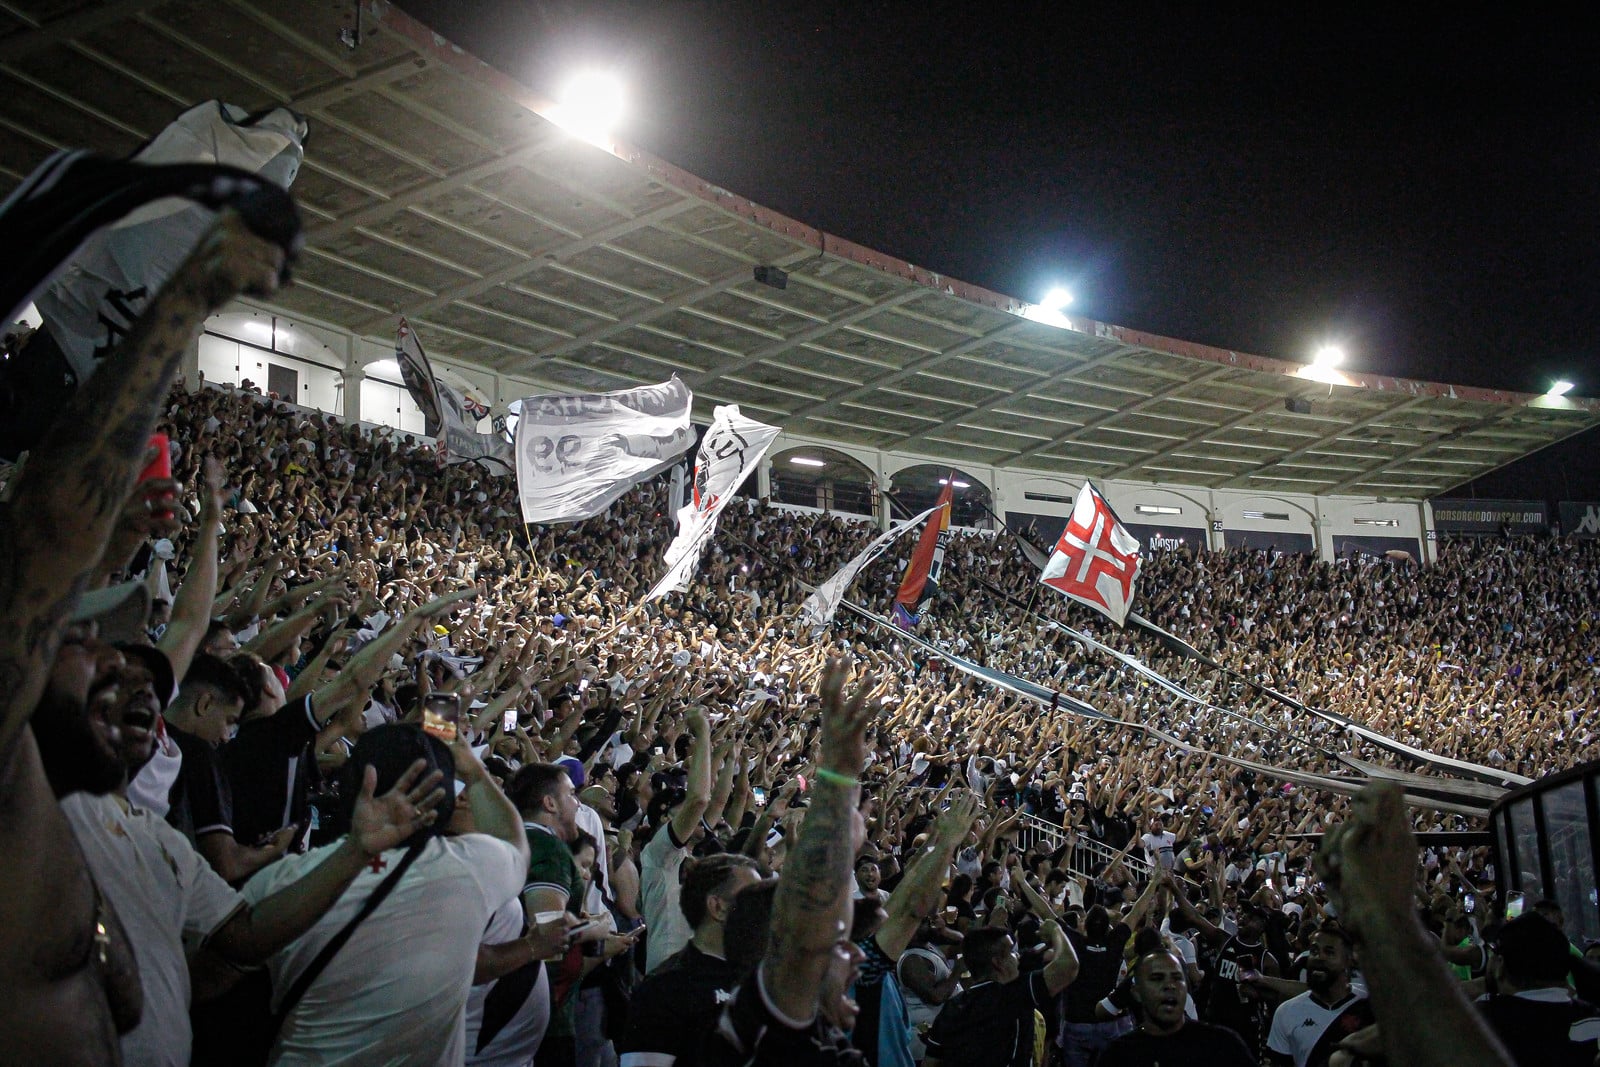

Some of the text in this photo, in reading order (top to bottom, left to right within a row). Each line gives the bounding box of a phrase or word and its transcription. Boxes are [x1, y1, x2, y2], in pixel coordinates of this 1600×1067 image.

[494, 418, 505, 431] 23
[1213, 522, 1223, 531] 25
[1426, 531, 1436, 539] 26
